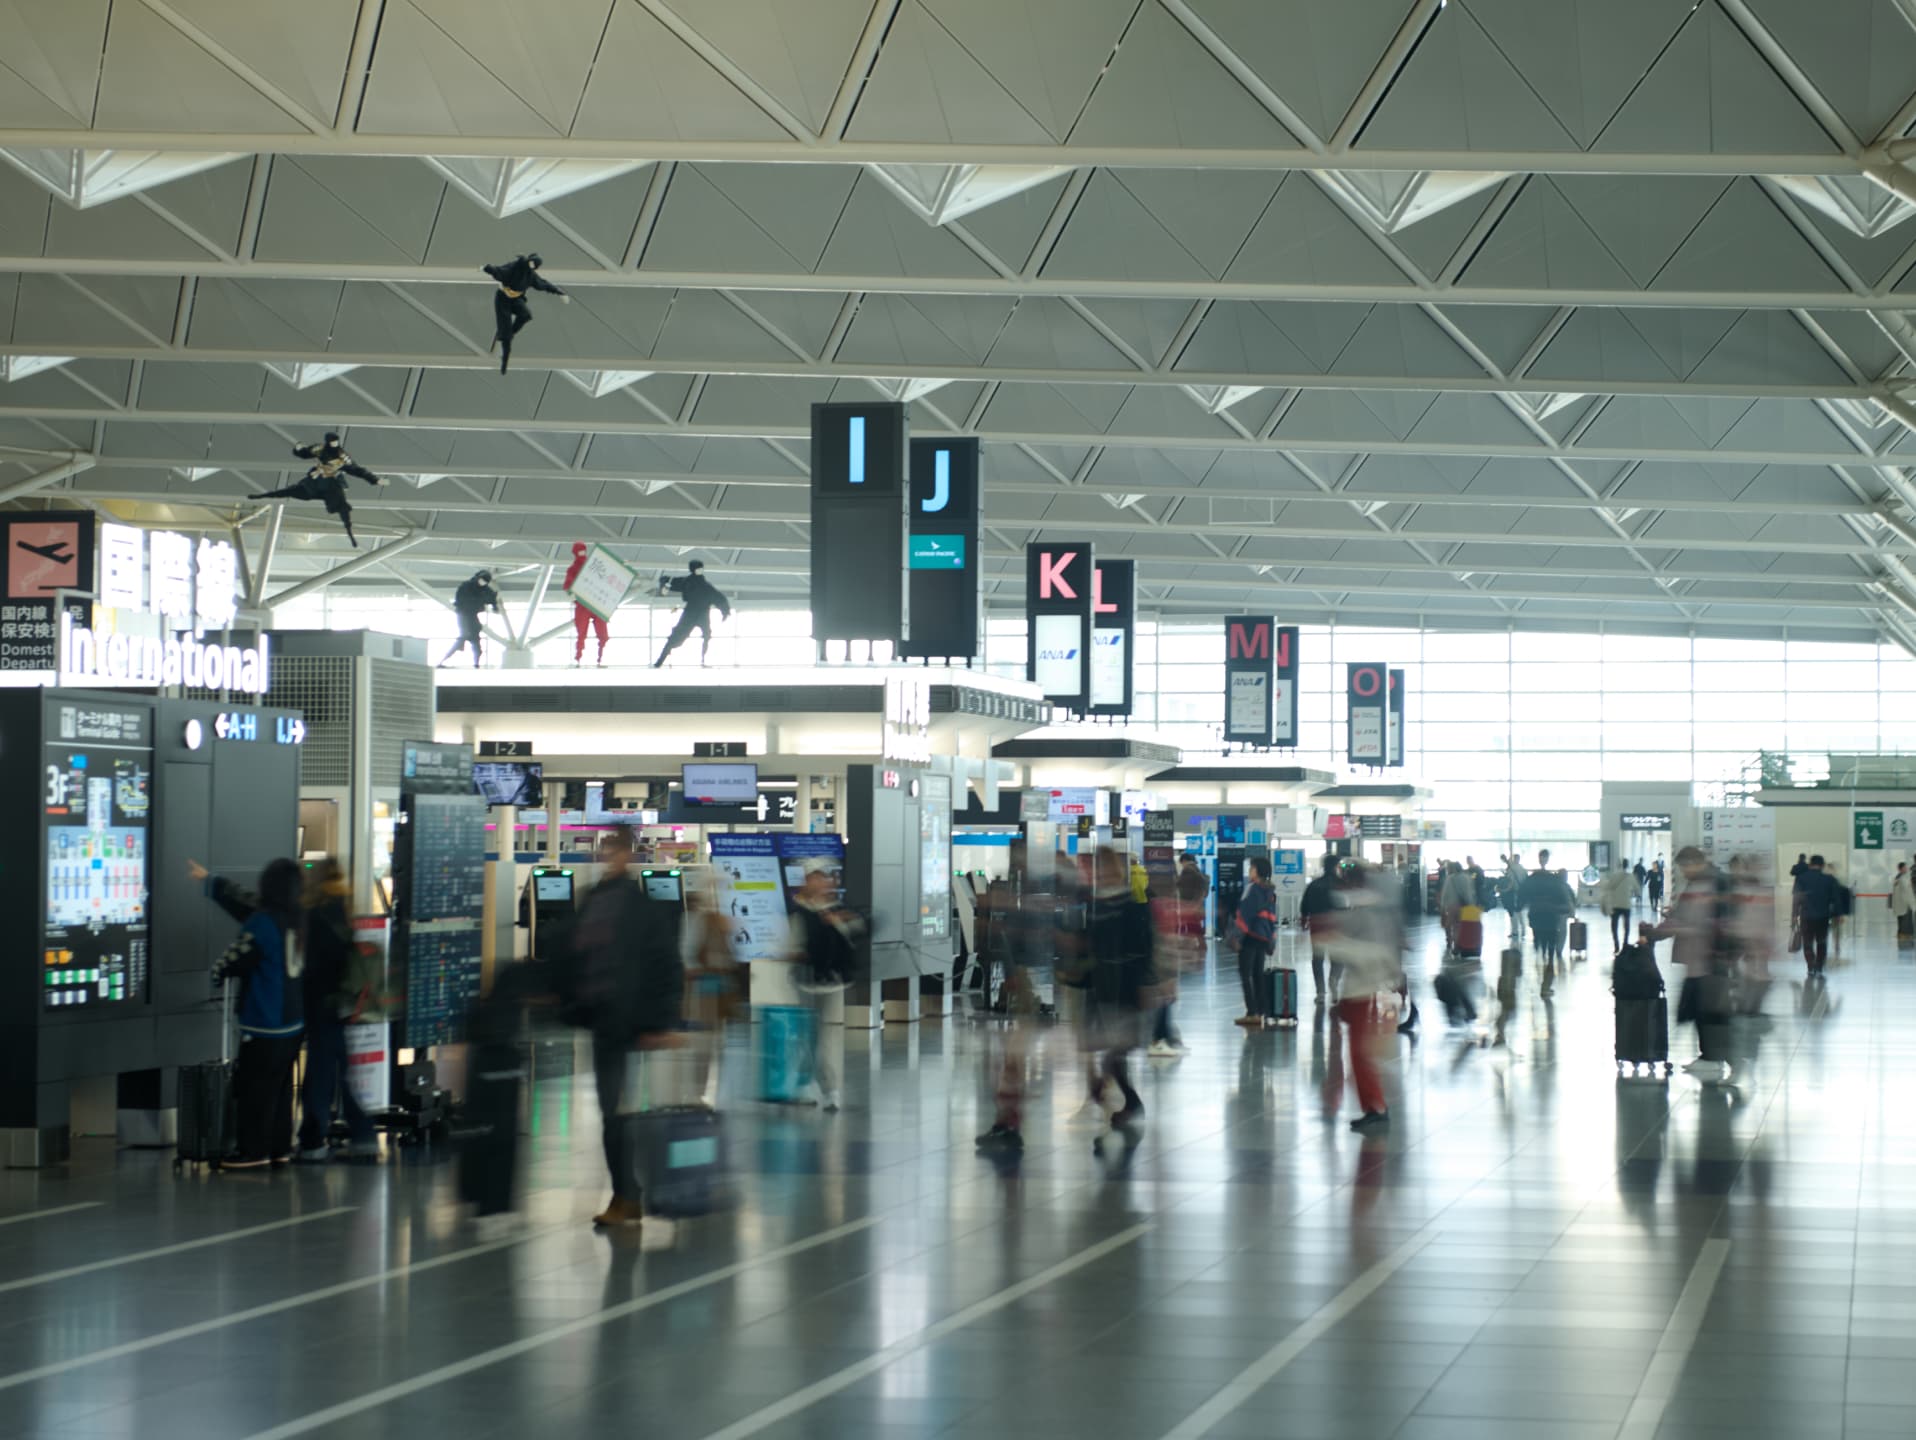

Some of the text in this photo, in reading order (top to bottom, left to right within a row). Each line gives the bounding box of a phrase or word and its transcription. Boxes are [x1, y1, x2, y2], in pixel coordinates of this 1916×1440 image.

[849, 417, 865, 482] I
[922, 450, 950, 511] J
[1040, 552, 1078, 599] K
[1093, 569, 1118, 612] L
[1, 606, 47, 620] 国内線
[1, 643, 55, 656] Domest
[61, 612, 268, 694] International
[1229, 623, 1269, 659] M
[1353, 668, 1381, 696] O
[46, 764, 69, 805] 3F
